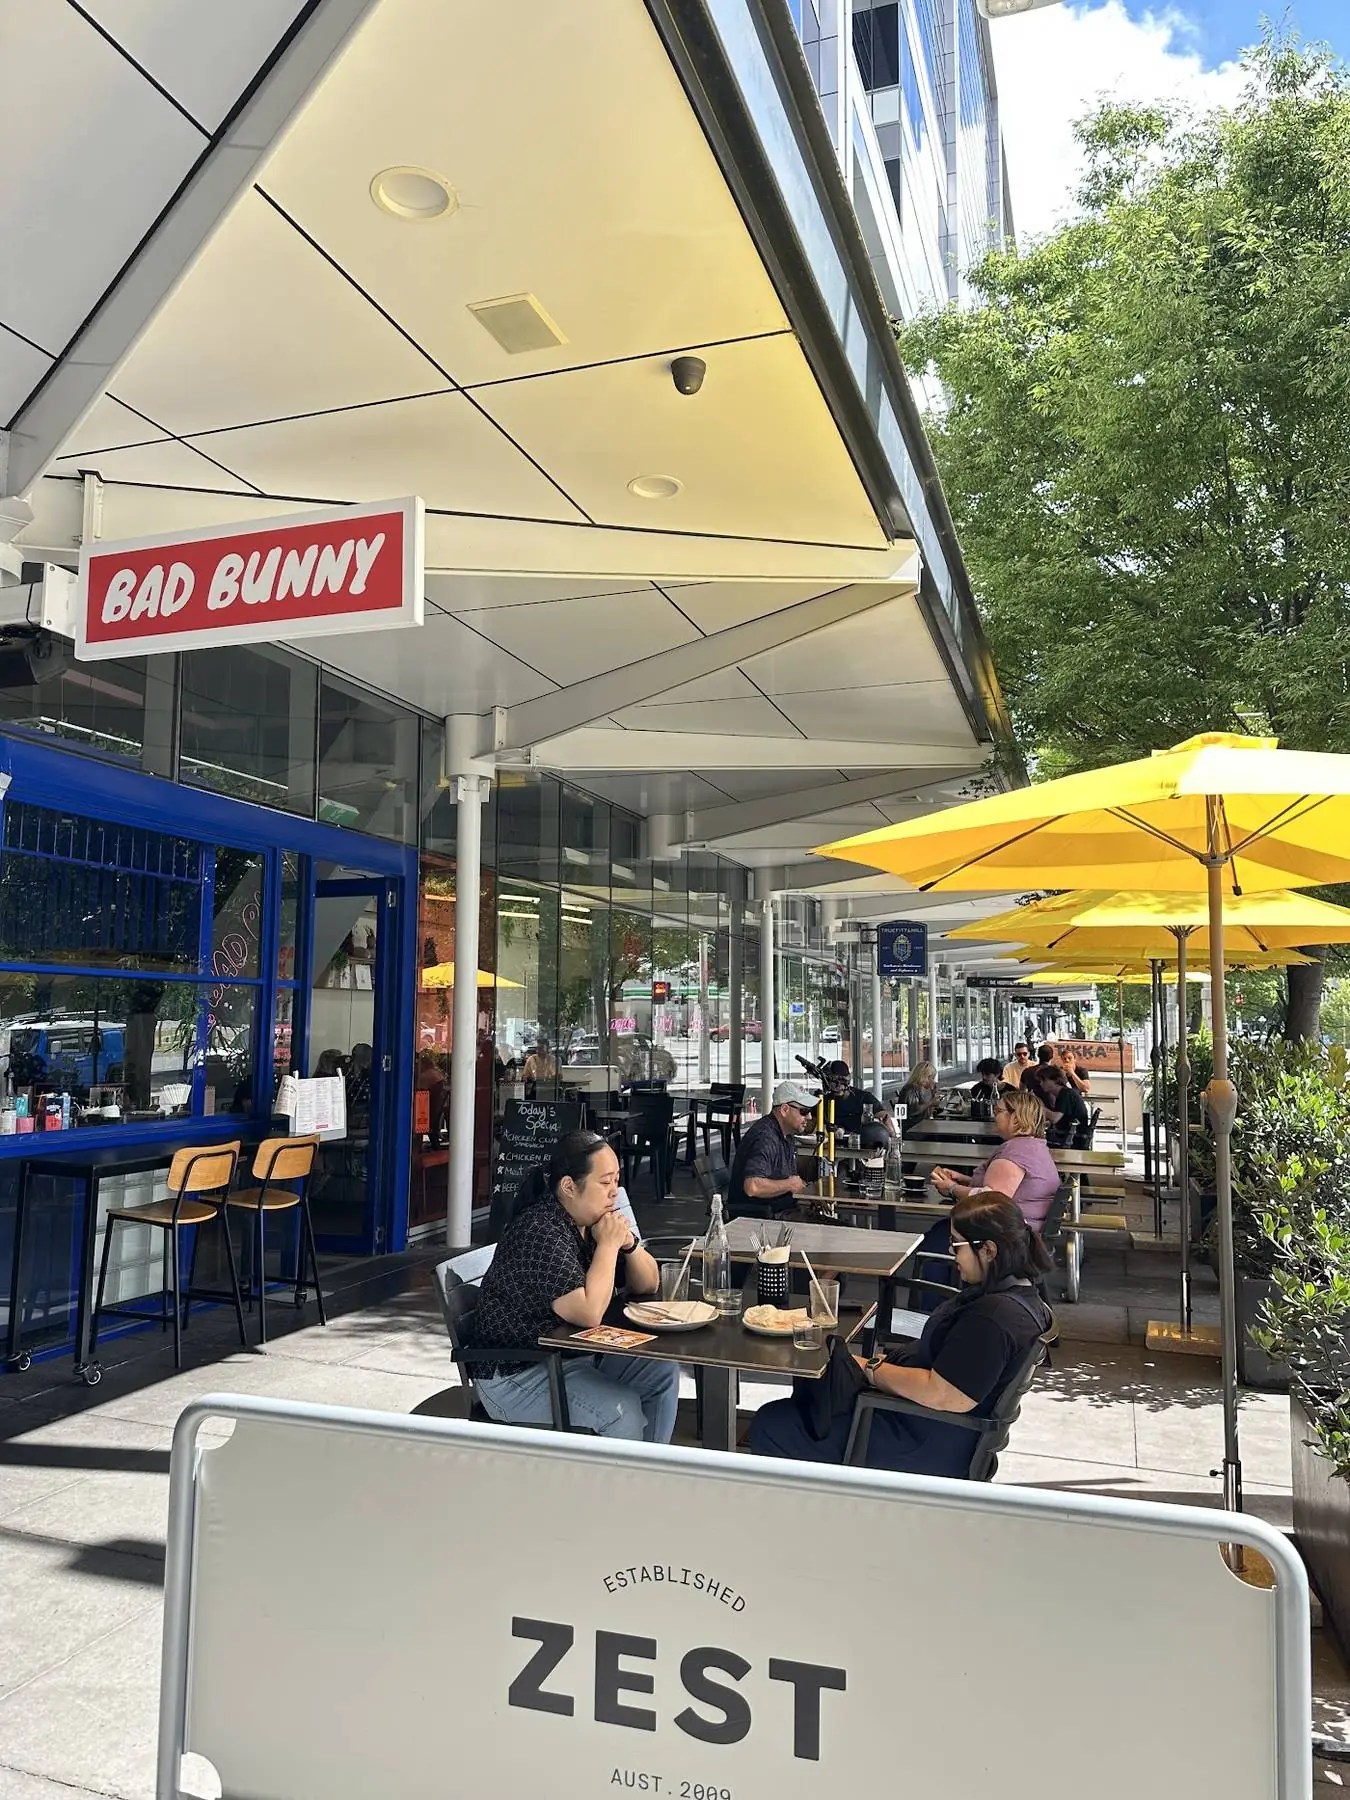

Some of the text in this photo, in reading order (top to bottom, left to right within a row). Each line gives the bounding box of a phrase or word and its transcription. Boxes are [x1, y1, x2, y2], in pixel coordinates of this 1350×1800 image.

[101, 532, 386, 624] BAD BUNNY
[515, 1102, 556, 1121] Today's
[896, 1106, 906, 1117] 10
[505, 1151, 542, 1162] CHICKEN
[603, 1565, 747, 1613] ESTABLISHED
[508, 1616, 847, 1761] ZEST
